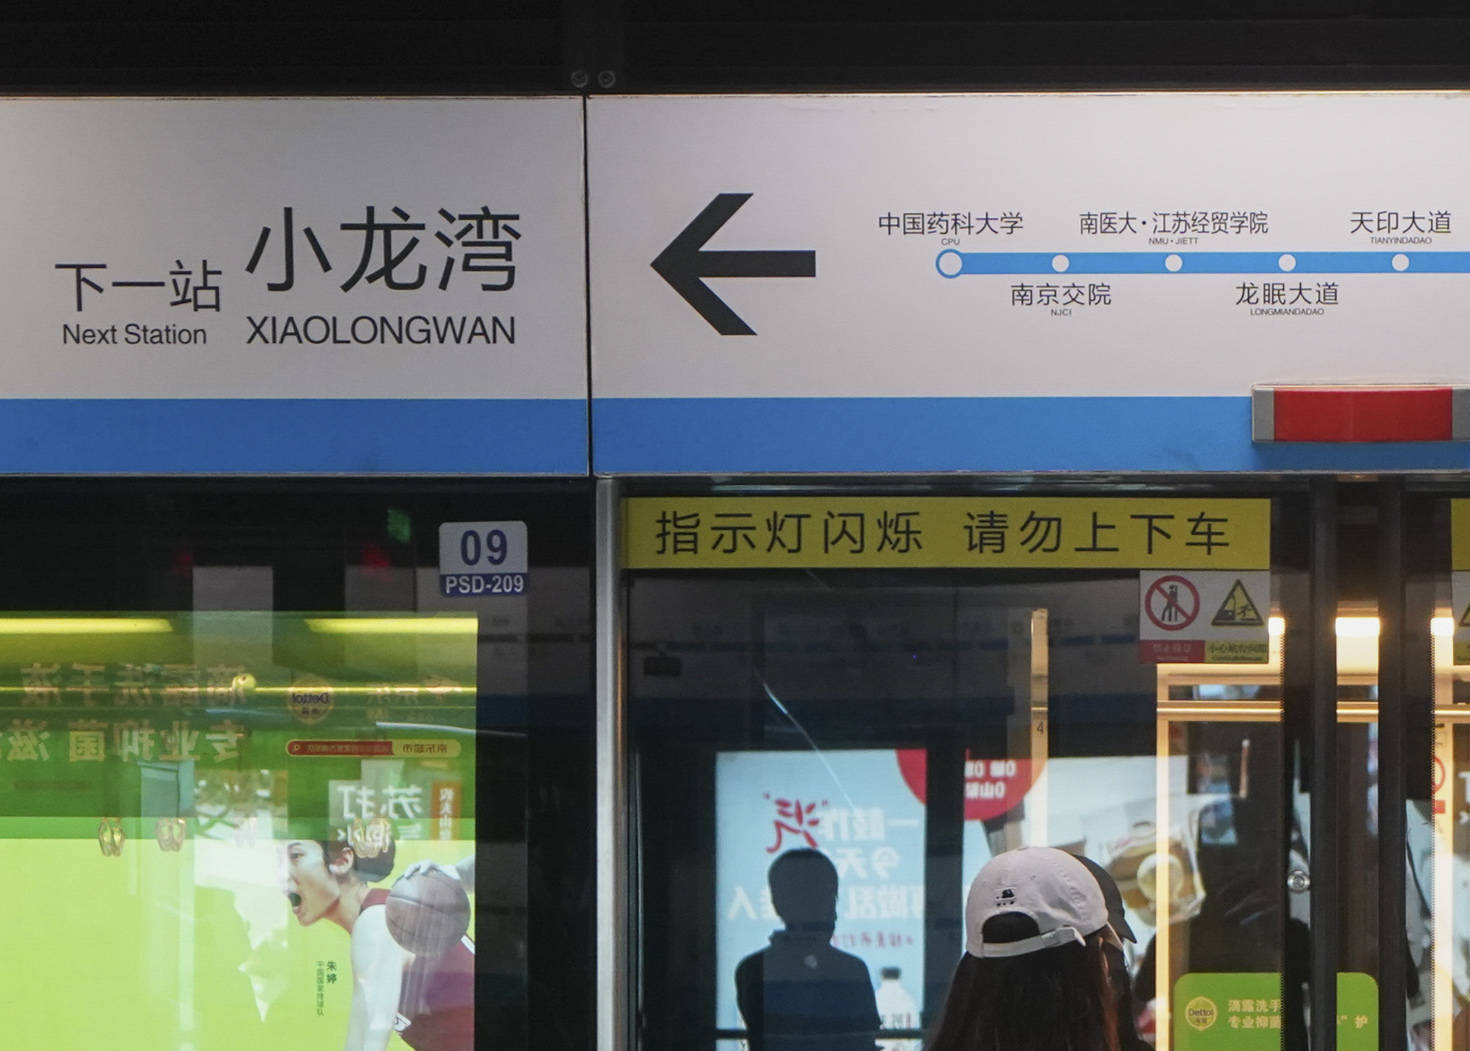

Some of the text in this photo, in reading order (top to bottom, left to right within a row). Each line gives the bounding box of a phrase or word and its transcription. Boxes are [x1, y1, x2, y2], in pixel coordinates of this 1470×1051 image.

[879, 212, 1023, 235] 中国药科大学
[1080, 211, 1268, 234] 南医大·江苏经贸学院
[1351, 211, 1451, 233] 天印大道
[245, 206, 521, 293] 小龙湾
[55, 260, 222, 312] 下一站
[1011, 283, 1111, 306] 南京交院
[1236, 282, 1338, 305] 龙眠大道
[63, 324, 206, 344] Next Station
[247, 316, 514, 344] XIAOLONGWAN
[656, 510, 1229, 555] 指示灯闪烁 请勿上下车
[461, 529, 507, 566] 09
[445, 573, 524, 594] PSD-209
